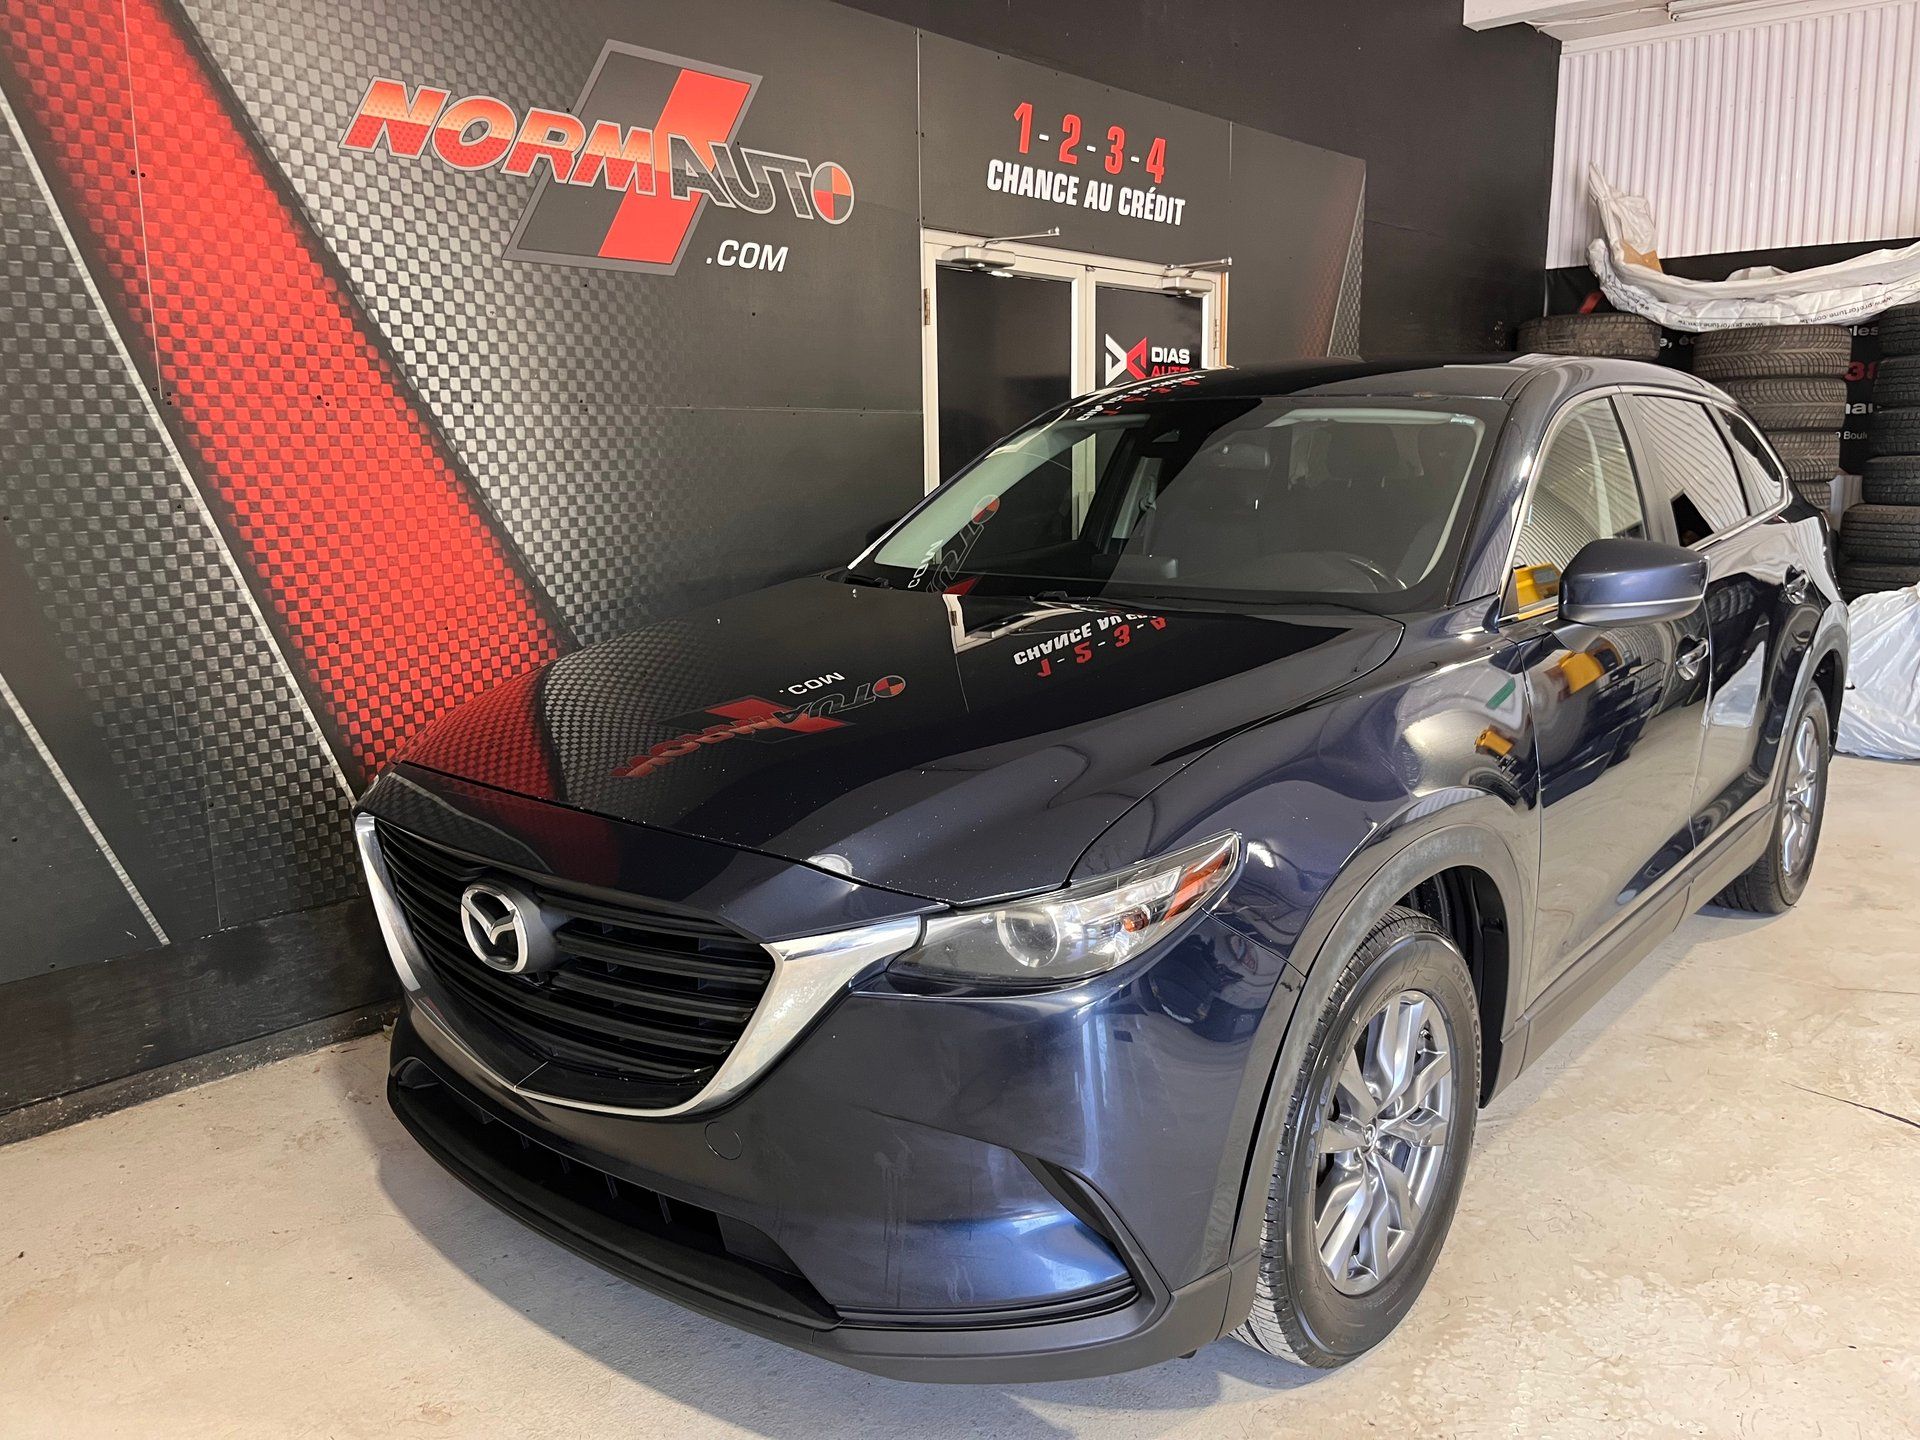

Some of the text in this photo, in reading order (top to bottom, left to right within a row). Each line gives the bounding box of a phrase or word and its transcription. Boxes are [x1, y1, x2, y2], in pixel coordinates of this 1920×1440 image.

[986, 159, 1186, 226] CHANCE AU CRÉDIT
[706, 238, 790, 273] .COM
[1151, 346, 1191, 365] DIAS
[1452, 963, 1476, 1014] OPEN
